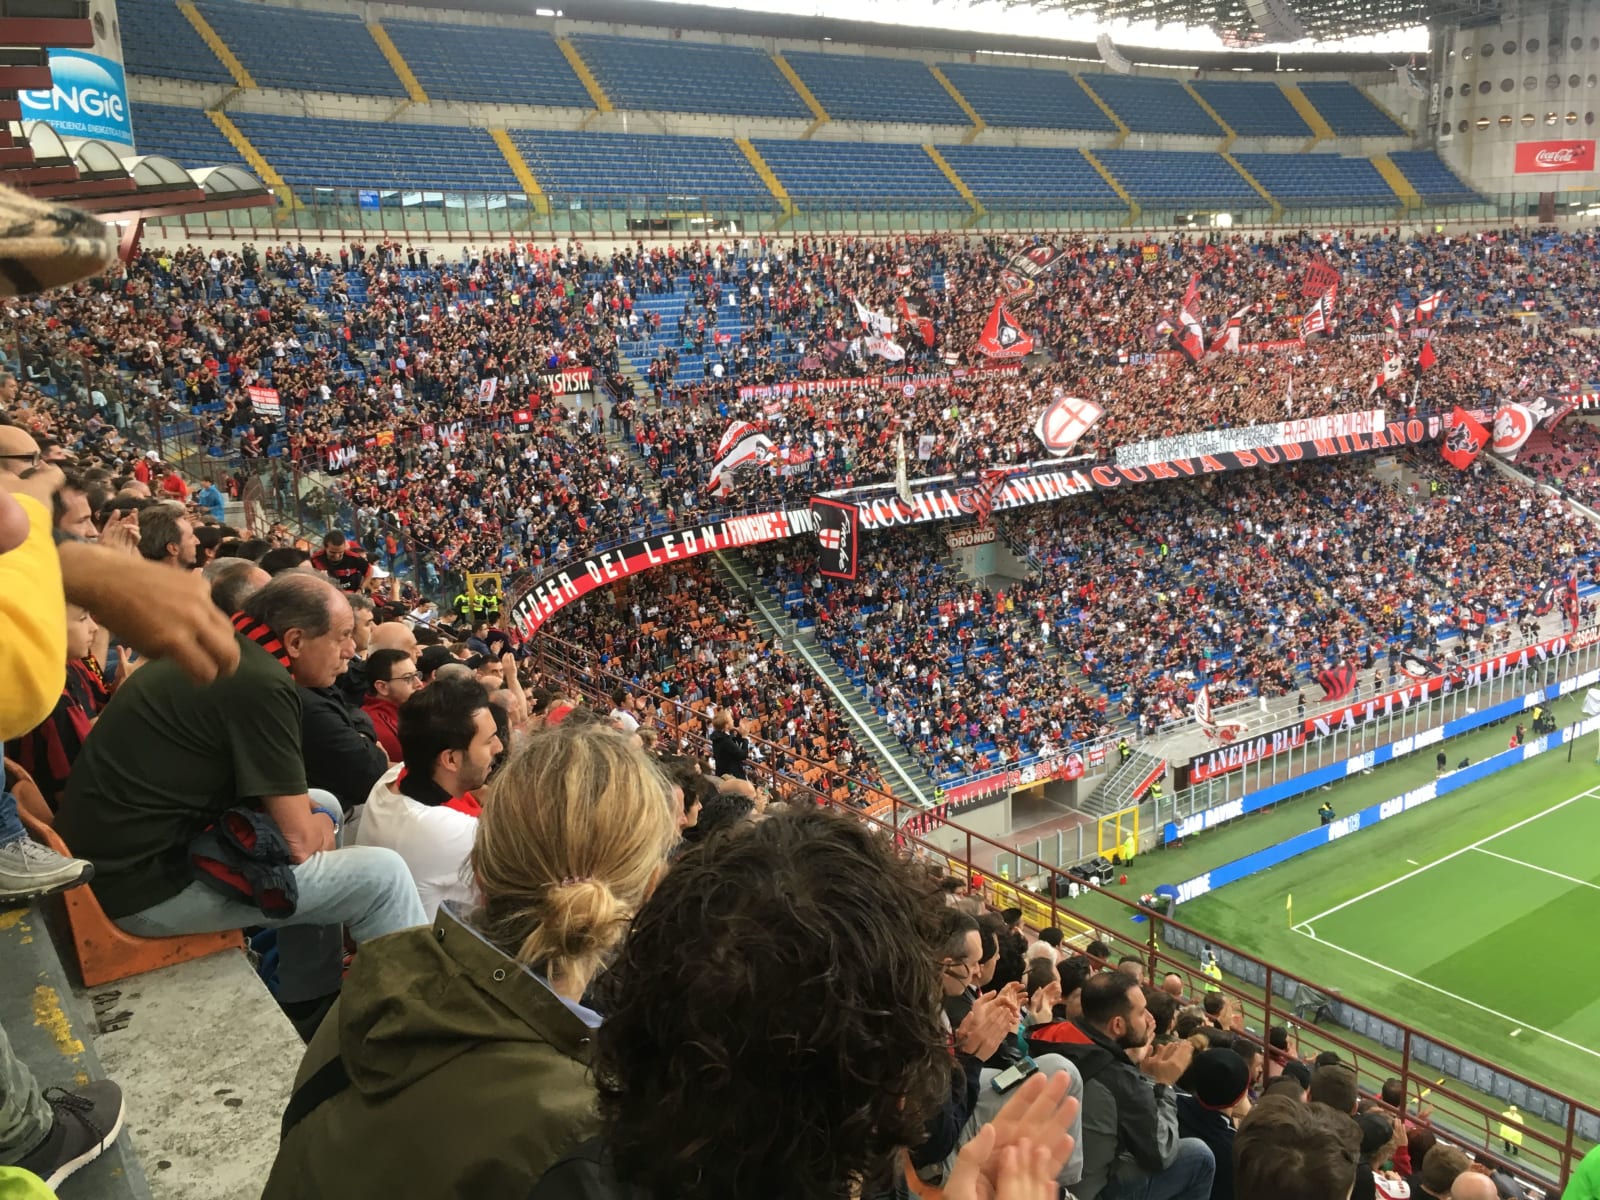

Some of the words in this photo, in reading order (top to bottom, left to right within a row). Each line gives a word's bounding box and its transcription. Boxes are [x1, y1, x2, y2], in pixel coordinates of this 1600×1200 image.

[1090, 453, 1226, 487] CURVA
[1233, 443, 1304, 468] SUD
[1311, 418, 1424, 457] MILANO
[519, 571, 579, 630] FOSSA
[584, 549, 630, 584] DEI
[642, 522, 730, 563] LEONI
[1206, 736, 1267, 775] ANELLO
[1272, 724, 1302, 755] BLU
[1313, 684, 1431, 741] NATIVI
